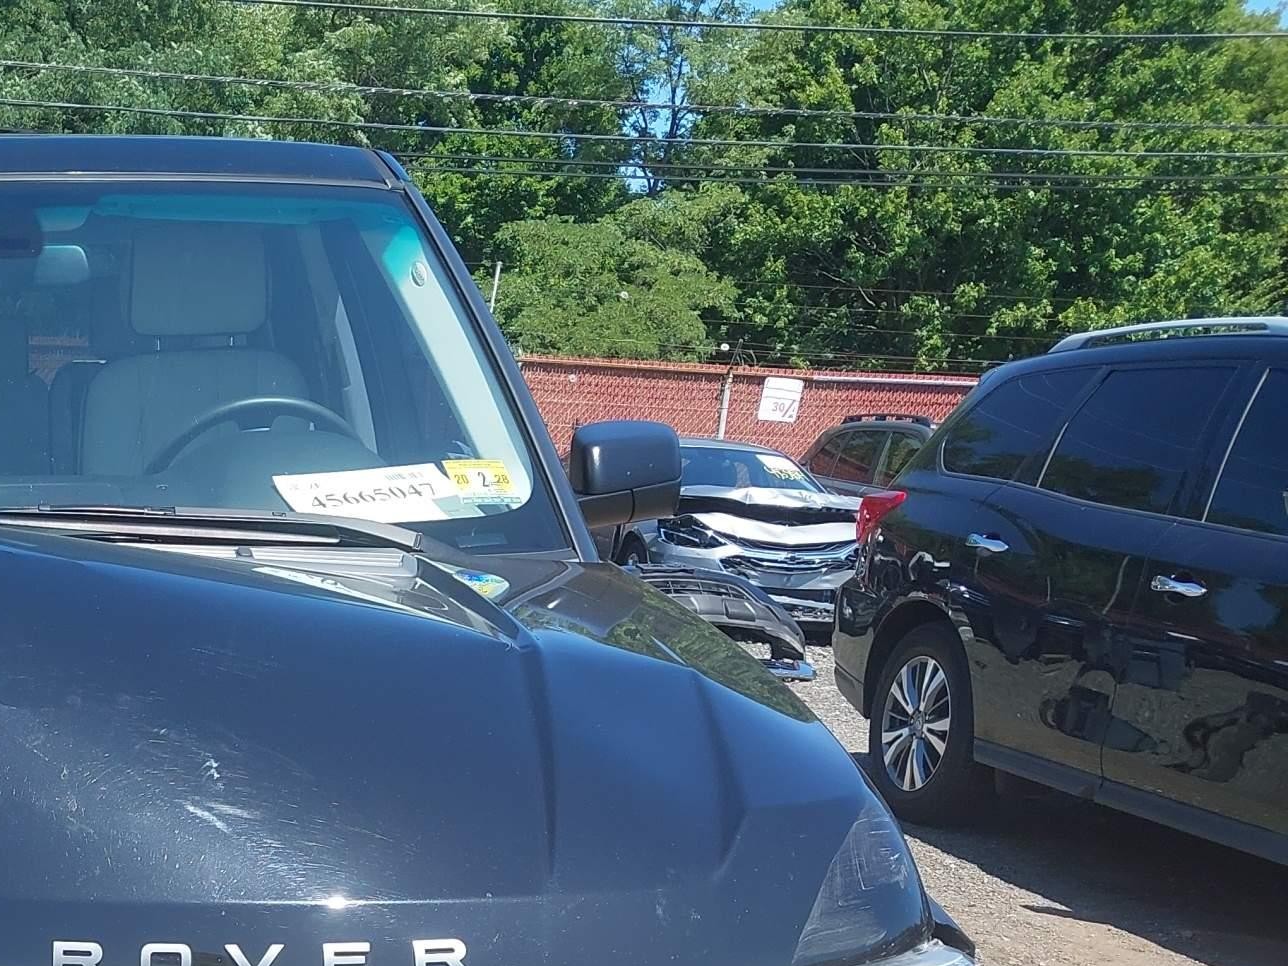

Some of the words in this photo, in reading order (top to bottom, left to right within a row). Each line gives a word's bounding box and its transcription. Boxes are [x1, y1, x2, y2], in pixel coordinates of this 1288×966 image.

[454, 474, 469, 485] 20
[477, 471, 489, 488] 2
[312, 483, 435, 509] 45665047
